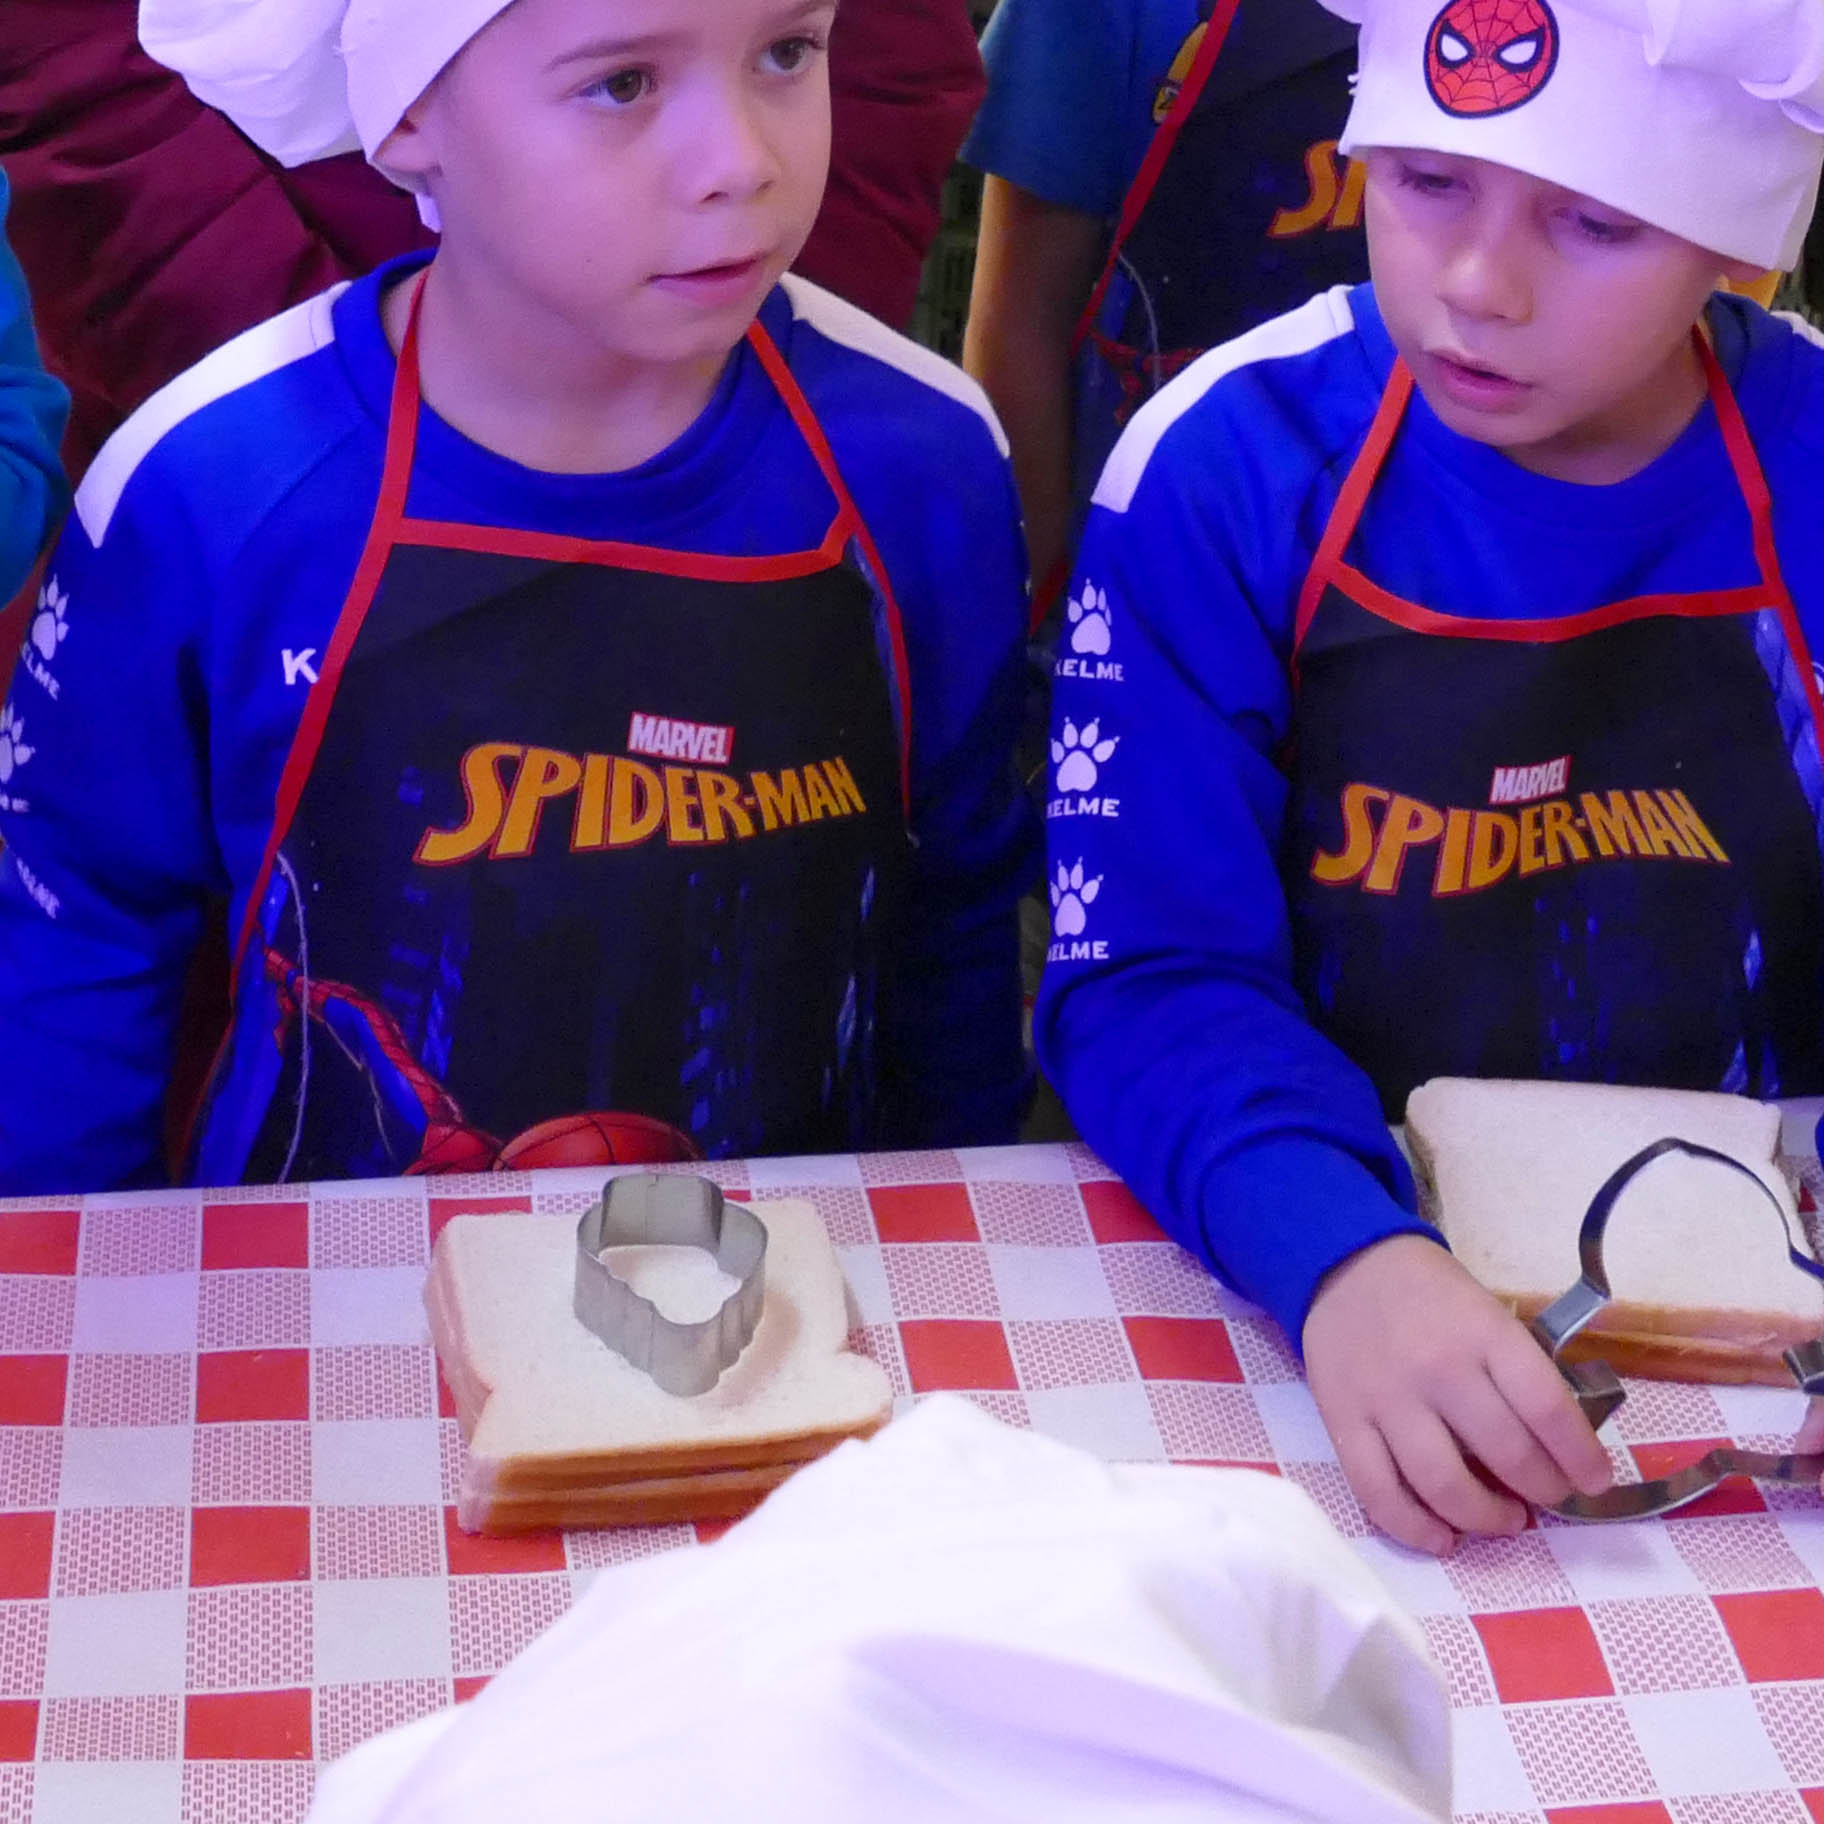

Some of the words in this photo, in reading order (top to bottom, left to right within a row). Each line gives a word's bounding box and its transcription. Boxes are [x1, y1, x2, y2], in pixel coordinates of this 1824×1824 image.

[631, 713, 730, 763] MARVEL
[1490, 756, 1568, 803] MARVEL
[412, 741, 866, 867] SPIDER-MAN
[1310, 782, 1731, 898] SPIDER-MAN
